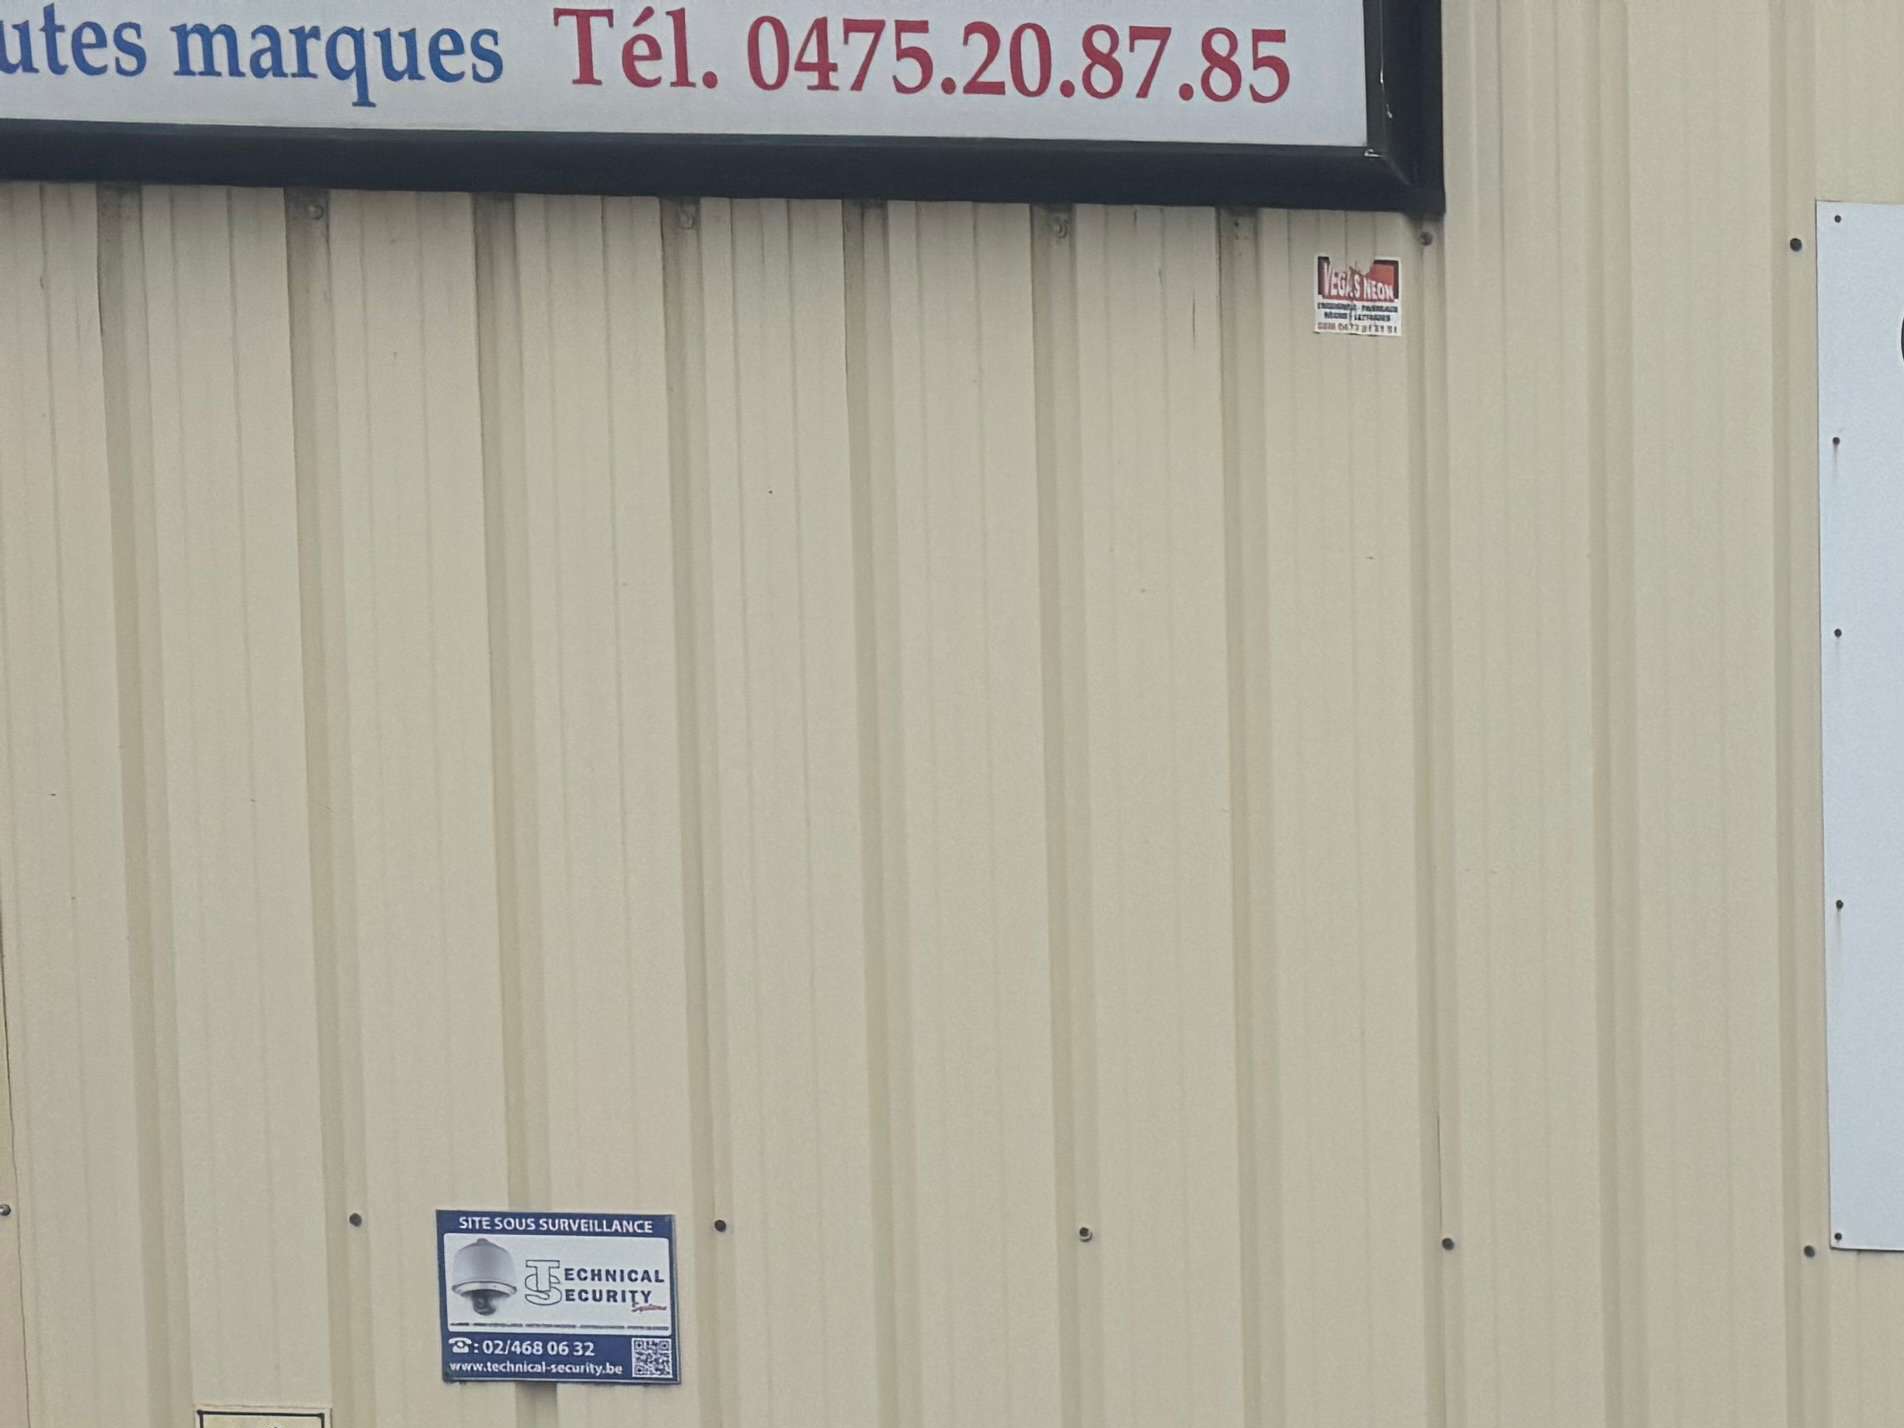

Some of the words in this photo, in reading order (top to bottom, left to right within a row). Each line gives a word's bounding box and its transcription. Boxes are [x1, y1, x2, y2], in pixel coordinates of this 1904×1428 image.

[0, 3, 147, 77] utes
[169, 23, 504, 108] marques
[553, 5, 719, 90] Tél.
[747, 15, 1291, 104] 0475.20.87.85
[1363, 277, 1394, 300] NEON
[458, 1216, 491, 1230] SITE
[494, 1216, 536, 1231] SOUS
[539, 1217, 653, 1233] SURVEILLANCE
[482, 1339, 543, 1356] 02/468
[546, 1341, 569, 1356] 06
[573, 1341, 595, 1357] 32
